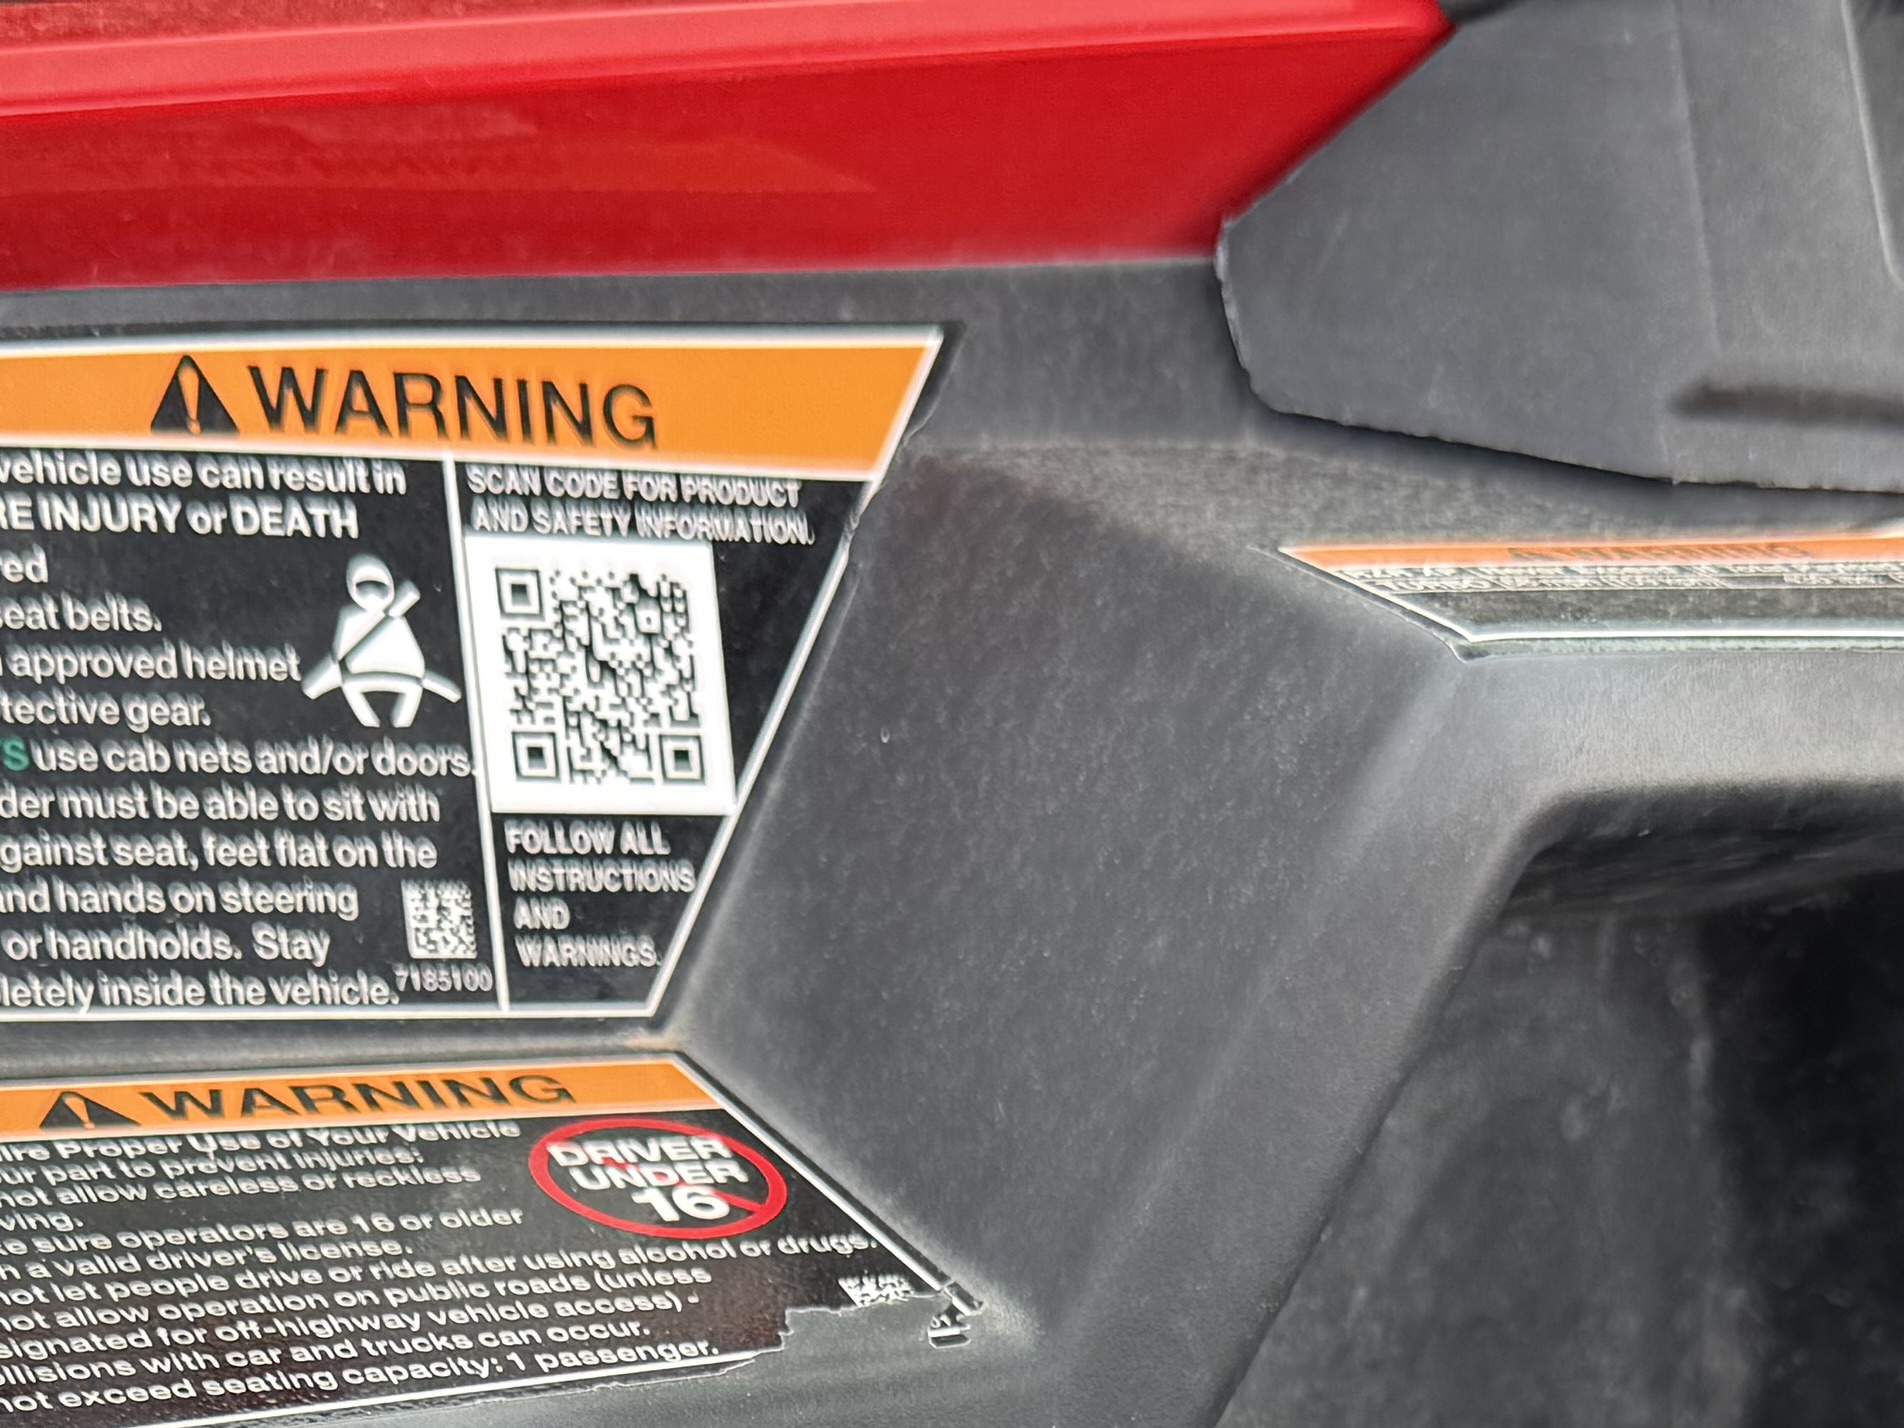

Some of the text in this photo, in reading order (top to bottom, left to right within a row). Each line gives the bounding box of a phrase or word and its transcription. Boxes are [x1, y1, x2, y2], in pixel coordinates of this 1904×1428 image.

[247, 365, 658, 449] WARNING
[38, 499, 181, 533] INJURY
[186, 504, 228, 534] or
[230, 503, 358, 538] DEATH
[62, 598, 162, 632] belts.
[8, 646, 178, 684] approved
[181, 647, 301, 681] helmet
[123, 696, 211, 733] gear.
[57, 788, 150, 819] must
[151, 788, 200, 820] be
[204, 789, 279, 820] able
[282, 789, 319, 821] to
[322, 790, 366, 821] sit
[367, 791, 440, 822] with
[110, 835, 199, 870] seat,
[202, 835, 271, 867] feet
[274, 836, 330, 867] flat
[332, 837, 379, 868] on
[381, 837, 437, 868] the
[505, 820, 670, 855] FOLLOW ALL
[508, 860, 695, 892] INSTRUCTIONS
[100, 973, 205, 1005] inside
[211, 973, 266, 1005] the
[271, 972, 399, 1004] vehicle.
[392, 963, 493, 992] 7185100
[139, 1075, 577, 1121] WARNING
[547, 1135, 733, 1166] DRIVER
[569, 1159, 748, 1190] UNDER
[631, 1185, 730, 1222] 16
[50, 1281, 102, 1302] let
[105, 1273, 230, 1302] people
[235, 1268, 323, 1295] drive
[328, 1265, 363, 1283] or
[369, 1259, 437, 1285] ride
[440, 1254, 517, 1283] after
[522, 1249, 616, 1276] using
[618, 1238, 737, 1271] alcohol
[739, 1240, 771, 1257] or
[777, 1229, 876, 1257] drugs.
[156, 1327, 208, 1346] for
[215, 1312, 421, 1341] off-highway
[427, 1300, 549, 1325] vehicle
[554, 1290, 683, 1317] access)
[139, 1350, 220, 1373] with
[225, 1348, 282, 1367] car
[289, 1339, 359, 1362] and
[361, 1332, 474, 1356] trucks
[478, 1328, 543, 1348] can
[546, 1321, 650, 1342] occur.
[58, 1378, 197, 1407] exceed
[202, 1371, 338, 1398] seating
[342, 1357, 503, 1384] capacity:
[506, 1351, 526, 1371] 1
[534, 1341, 720, 1372] passenger.
